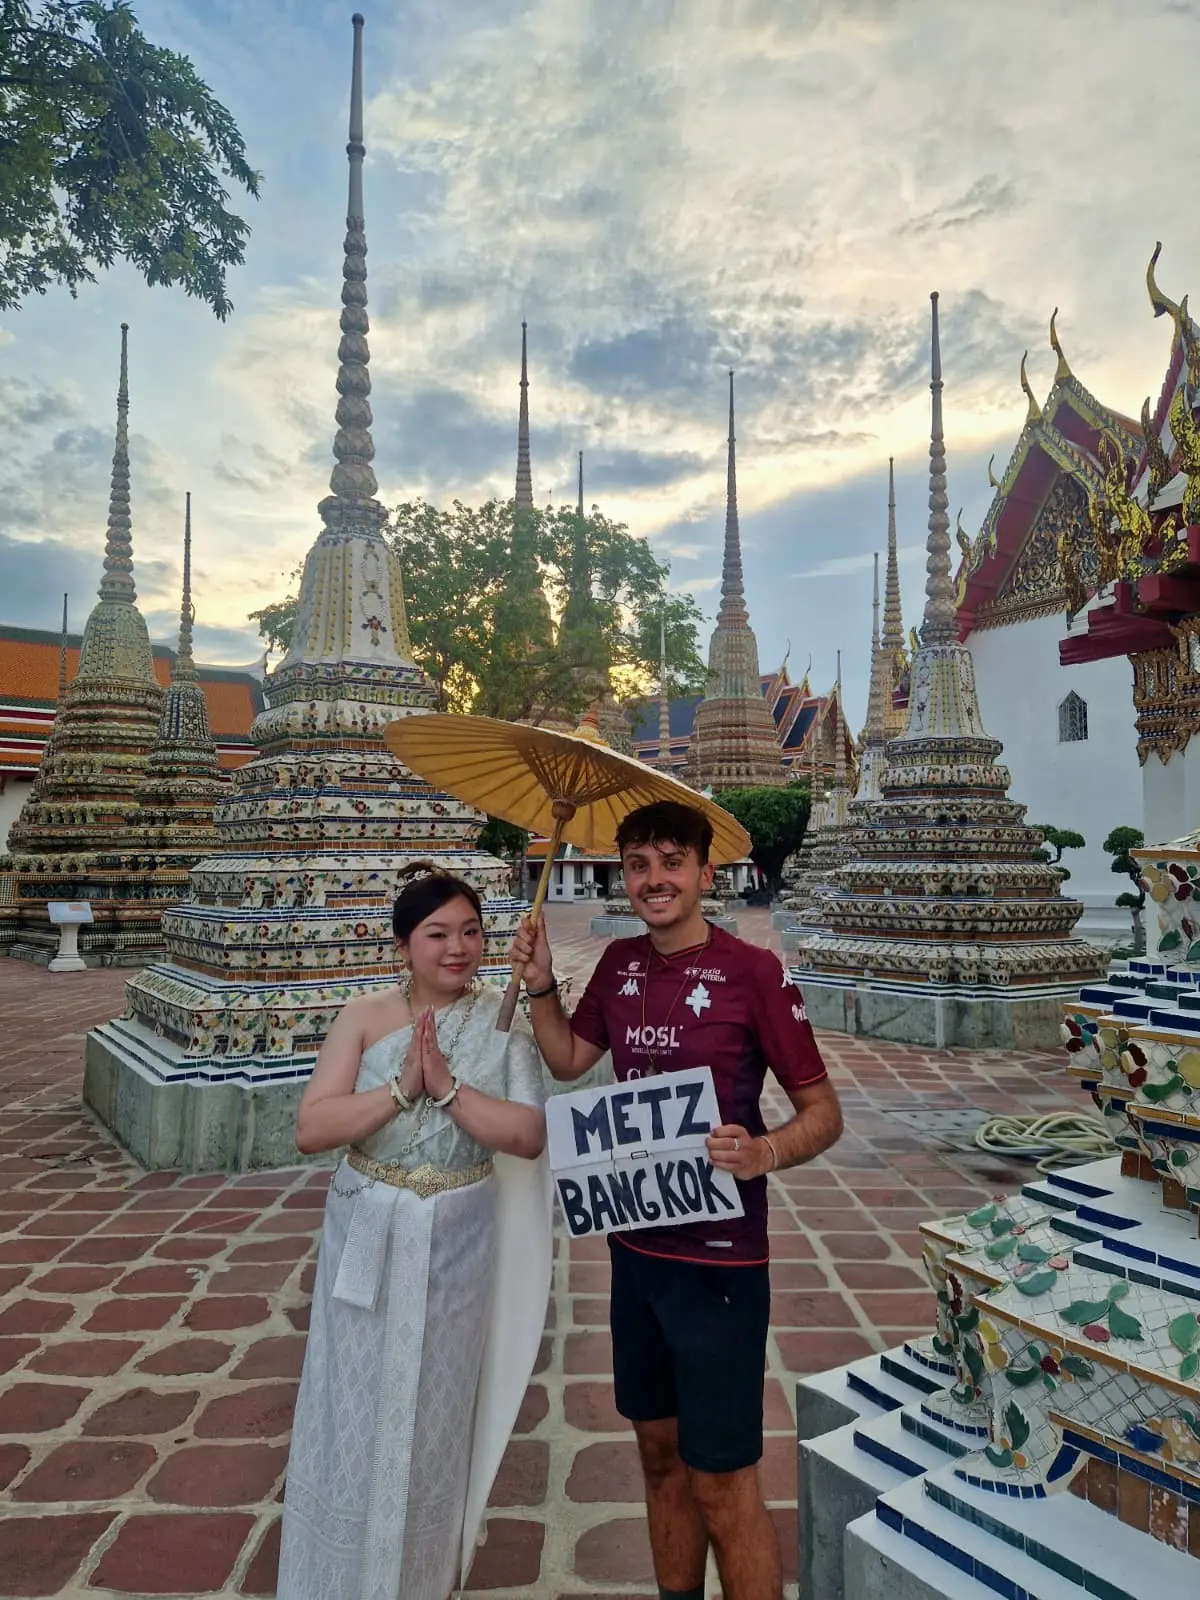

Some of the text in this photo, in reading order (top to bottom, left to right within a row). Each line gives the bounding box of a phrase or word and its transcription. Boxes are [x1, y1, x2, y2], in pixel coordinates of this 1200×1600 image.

[699, 974, 726, 983] INTERIM
[571, 1082, 711, 1156] METZ
[557, 1157, 735, 1235] BANGKOK
